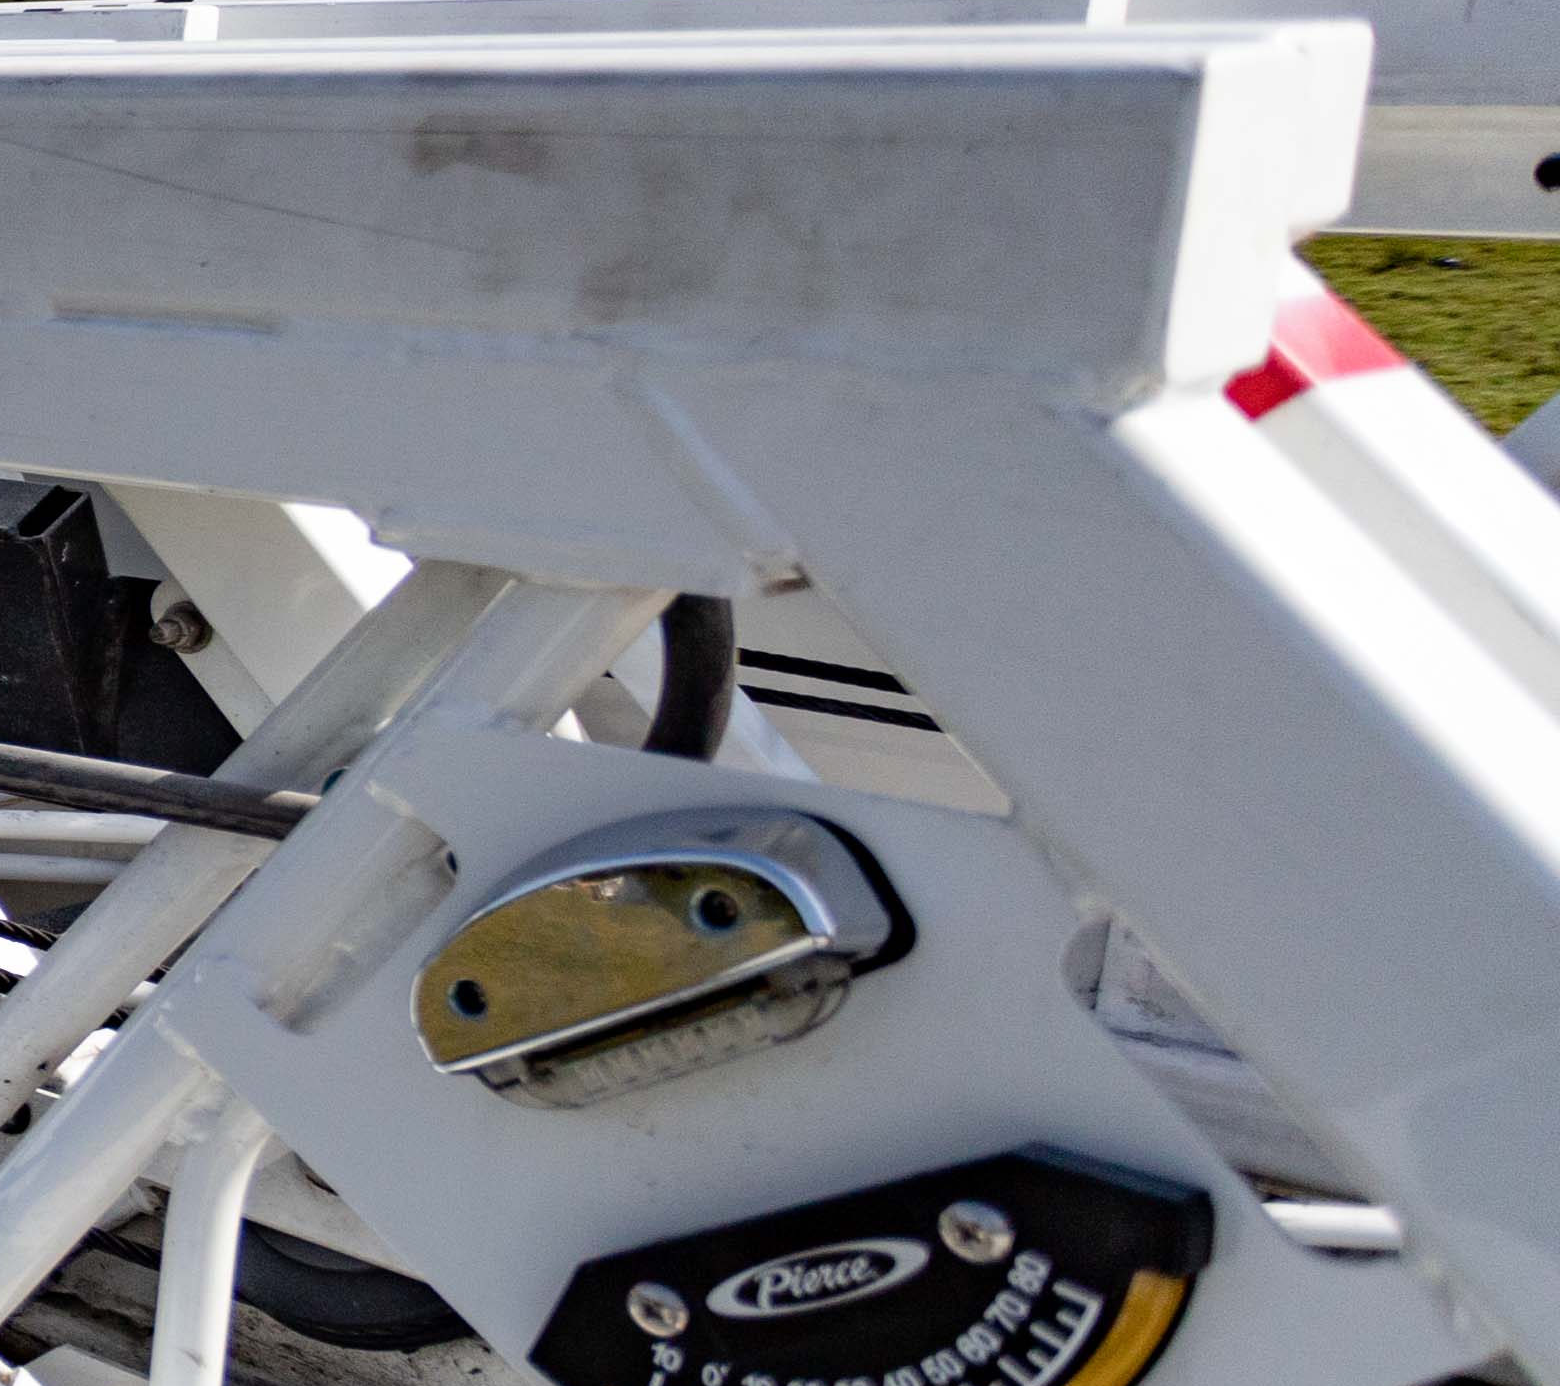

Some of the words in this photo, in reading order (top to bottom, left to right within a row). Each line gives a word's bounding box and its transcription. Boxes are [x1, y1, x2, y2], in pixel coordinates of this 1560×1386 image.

[651, 1343, 683, 1373] 10
[921, 1350, 966, 1386] 50
[955, 1322, 1003, 1364] 60
[983, 1290, 1031, 1334] 70
[1007, 1250, 1051, 1295] 80
[755, 1256, 870, 1311] Pierce
